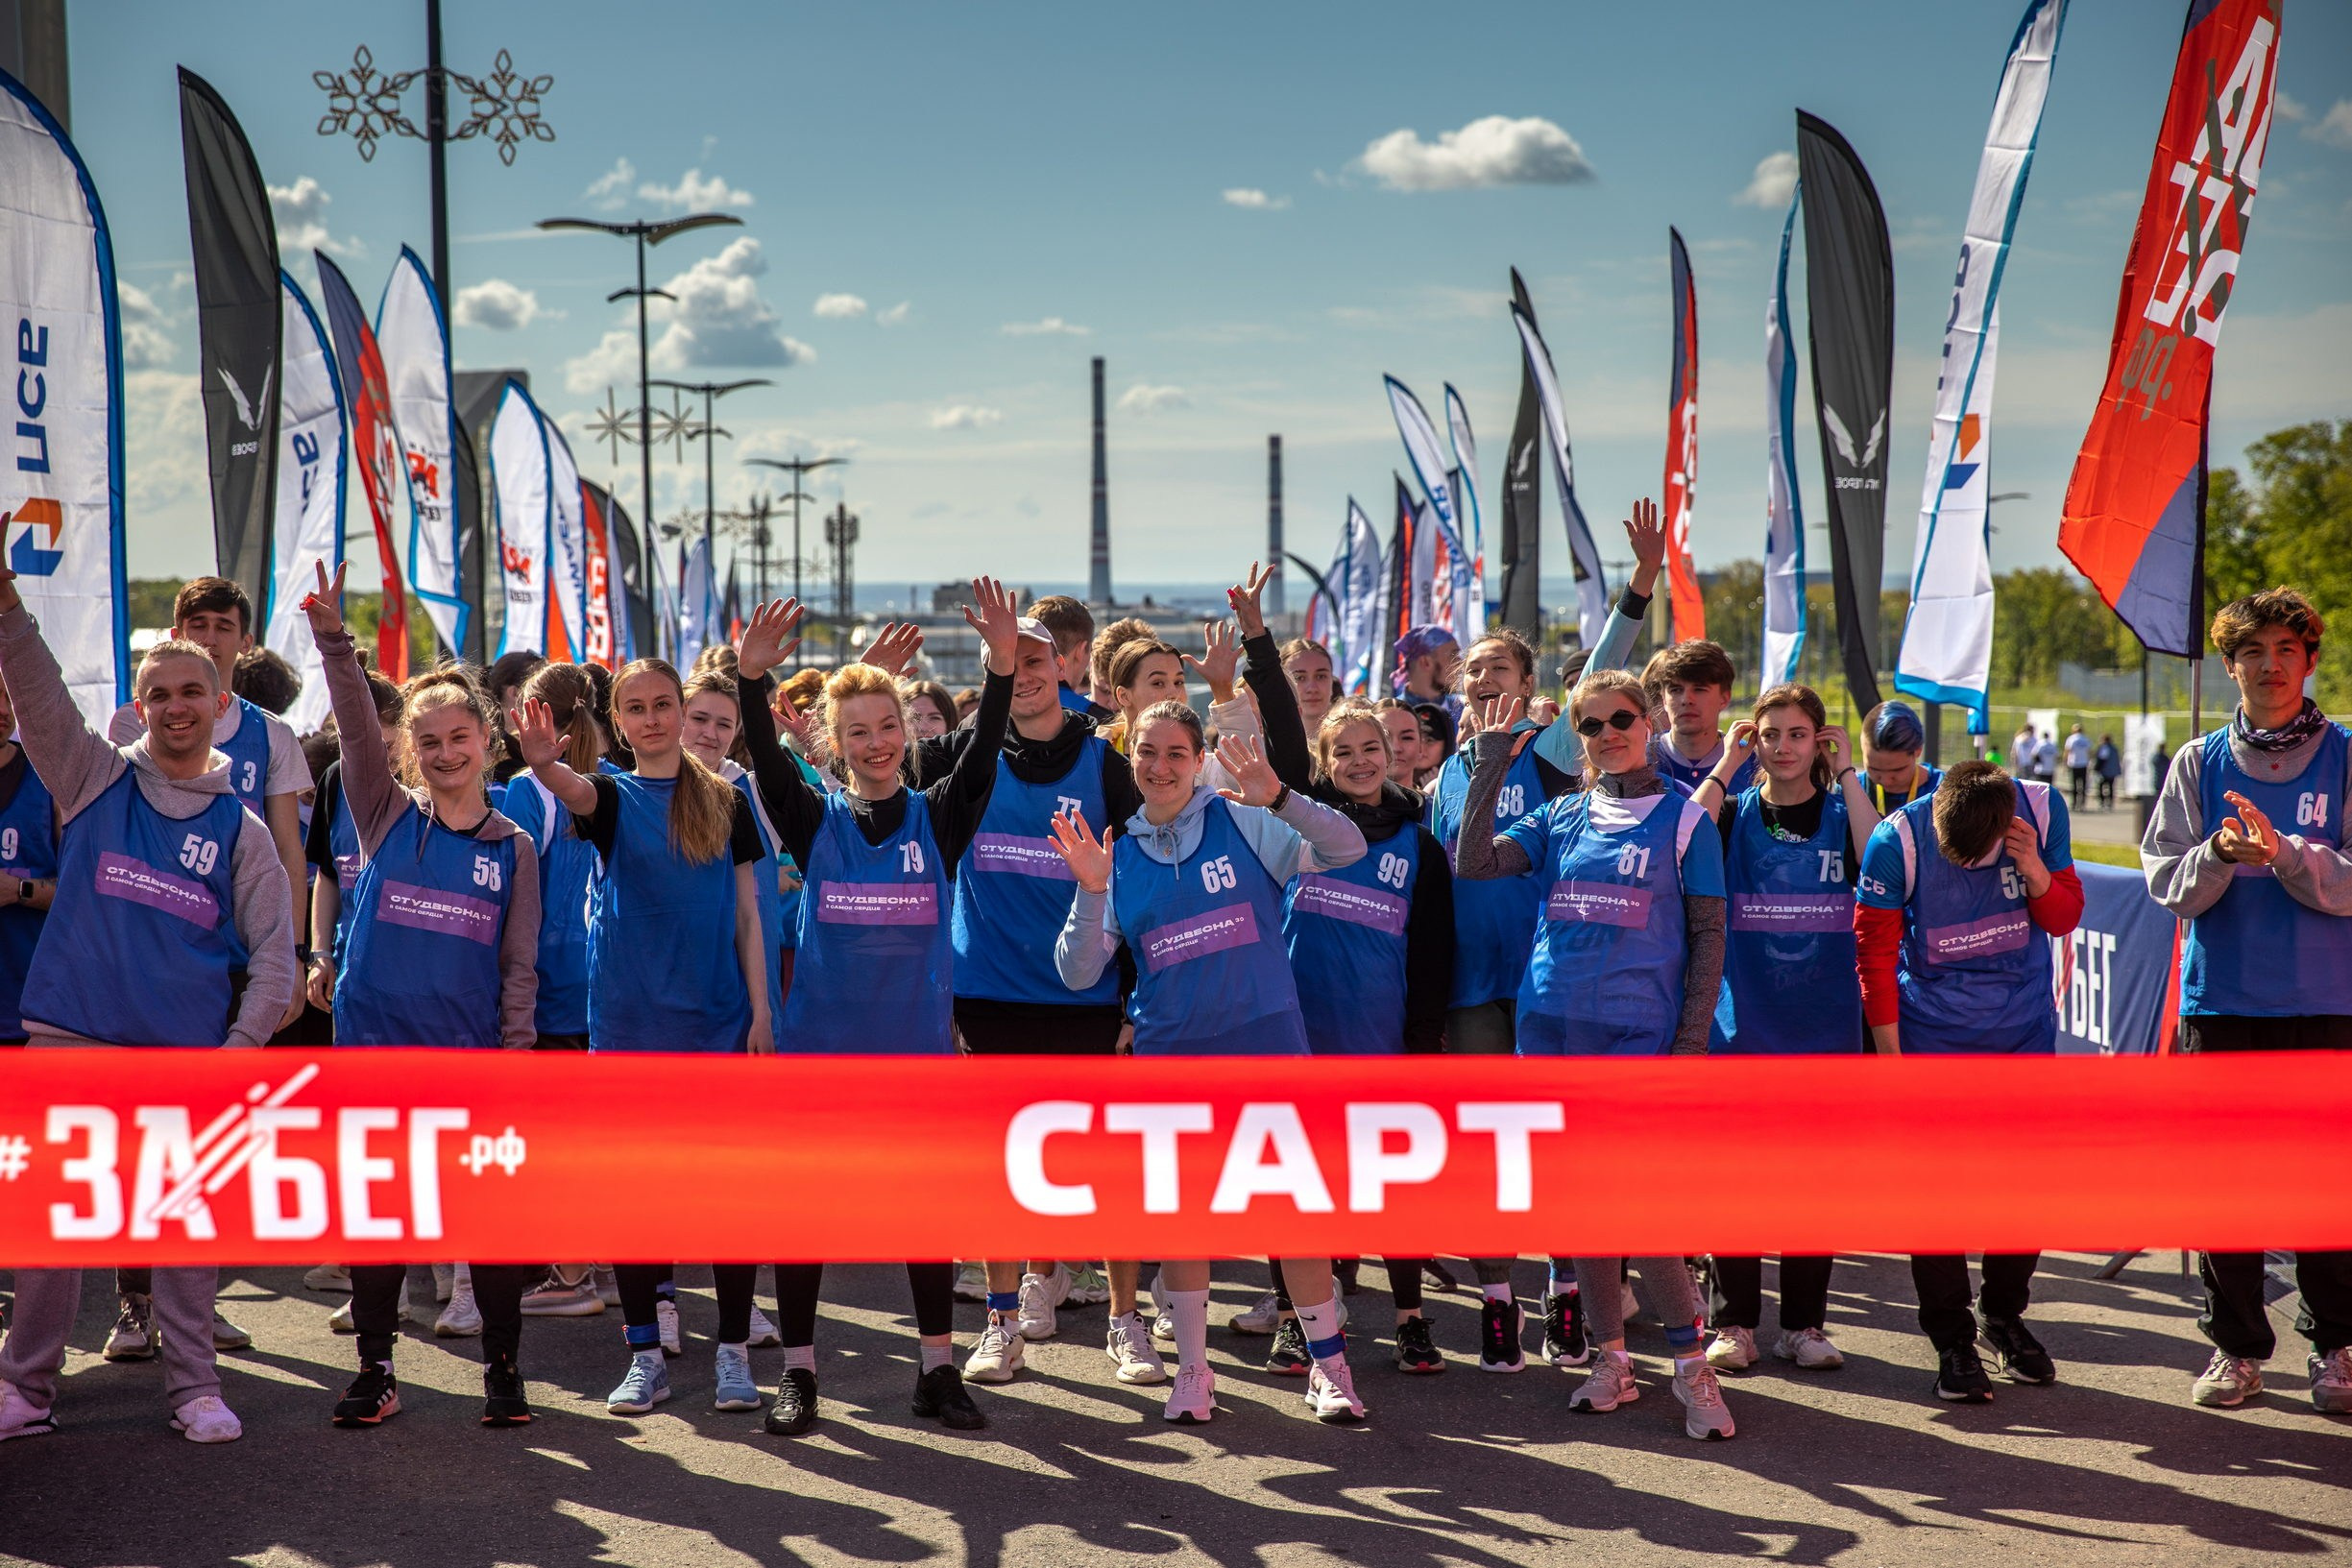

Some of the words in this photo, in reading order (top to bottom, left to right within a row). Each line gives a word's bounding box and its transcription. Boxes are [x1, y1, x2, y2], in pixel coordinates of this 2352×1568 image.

[242, 760, 256, 793] 3
[2296, 792, 2328, 828] 64
[1, 828, 18, 860] 9
[180, 833, 219, 876] 59
[1617, 843, 1651, 879] 81
[473, 854, 501, 892] 58
[1200, 855, 1237, 894] 65
[1377, 852, 1409, 889] 99
[1818, 850, 1845, 883] 75
[107, 866, 200, 903] СТУДВЕСНА
[826, 895, 919, 905] СТУДВЕСНА
[1306, 885, 1391, 912] СТУДВЕСНА
[390, 895, 480, 920] СТУДВЕСНА
[1151, 919, 1235, 951] СТУДВЕСНА
[1938, 921, 2028, 947] СТУДВЕСНА
[1005, 1099, 1565, 1216] СТАРТ
